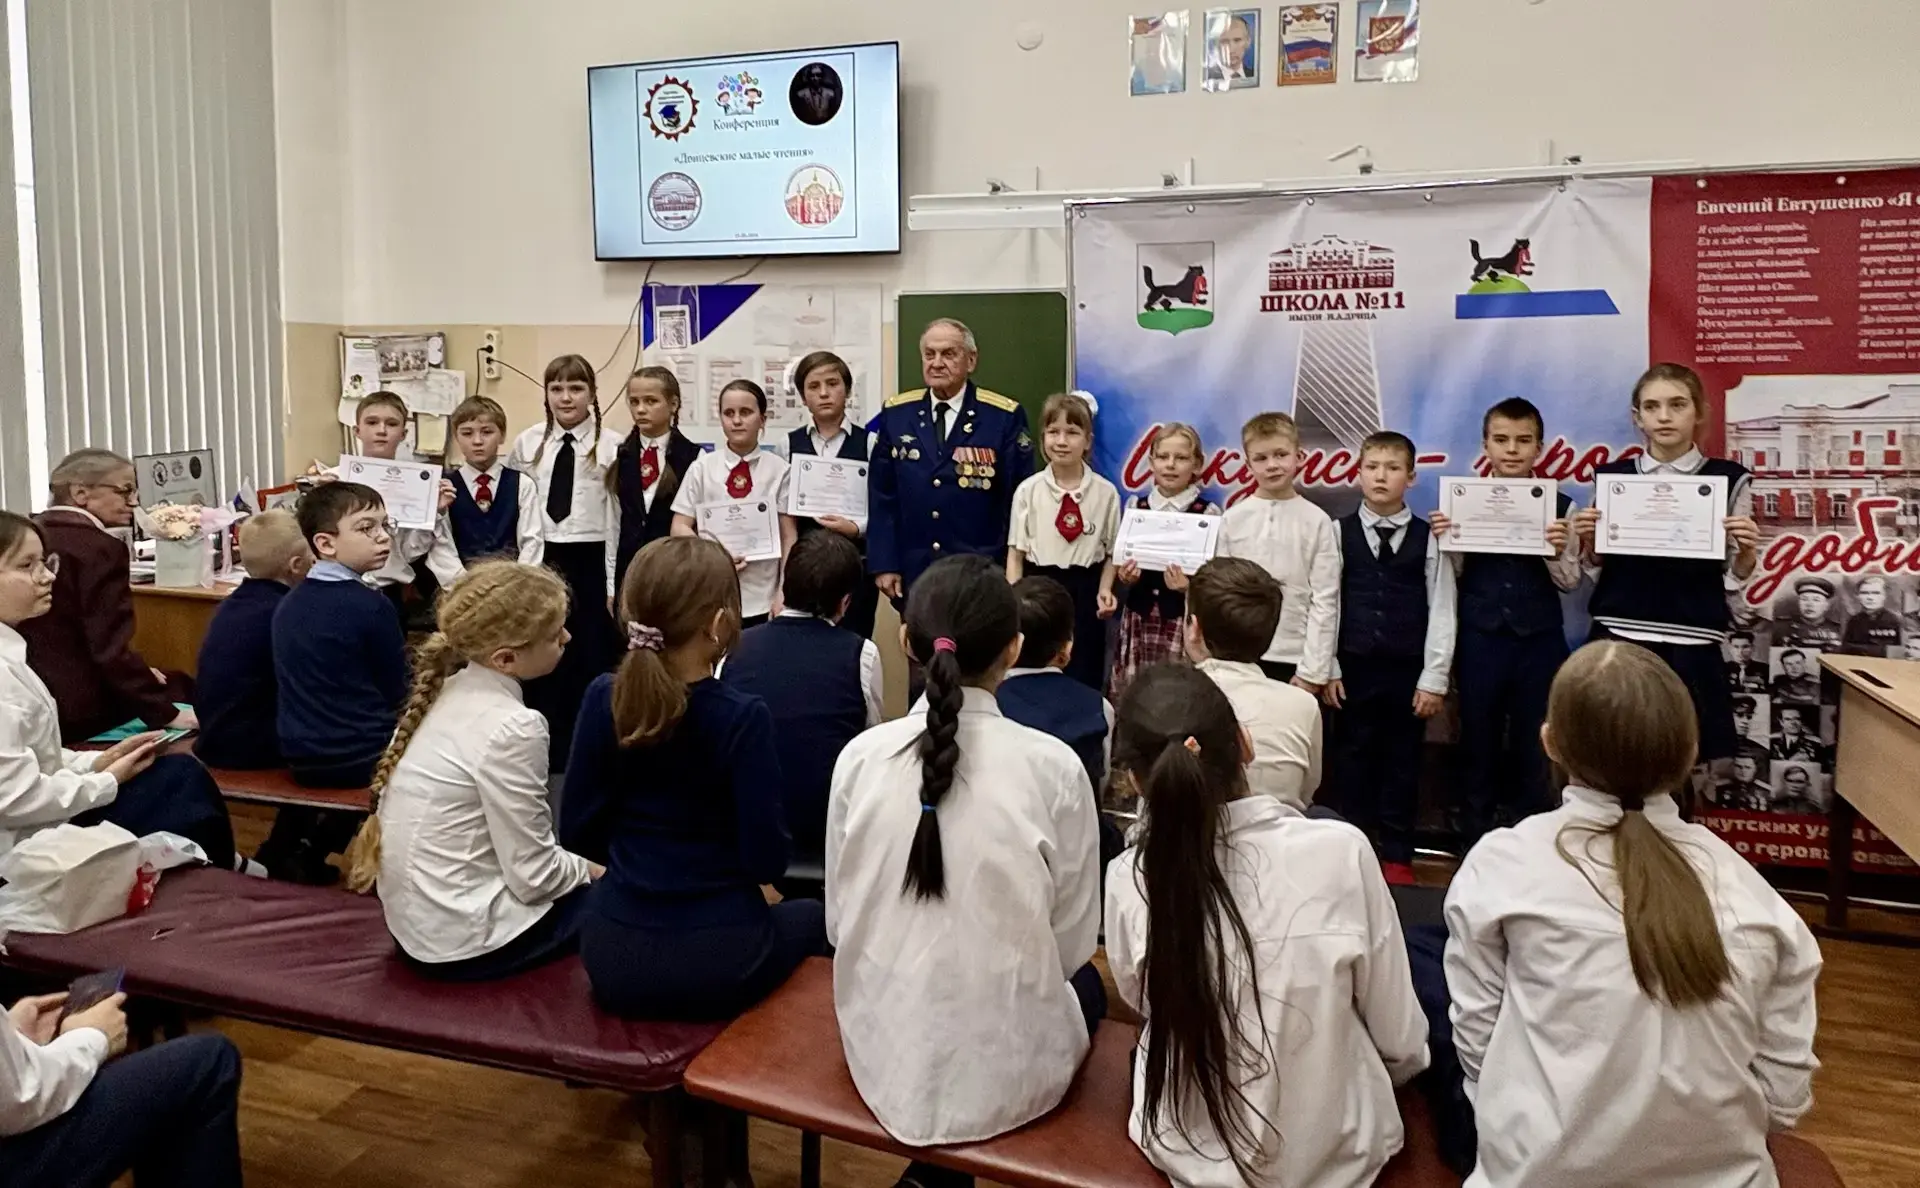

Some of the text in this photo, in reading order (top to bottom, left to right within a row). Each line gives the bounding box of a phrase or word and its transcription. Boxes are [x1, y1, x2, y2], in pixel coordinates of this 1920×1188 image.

[713, 117, 780, 132] Конференция
[739, 150, 771, 161] малые
[1696, 191, 1913, 215] Евгений Евтушенко «Я
[1260, 291, 1406, 312] ШКОЛА №11
